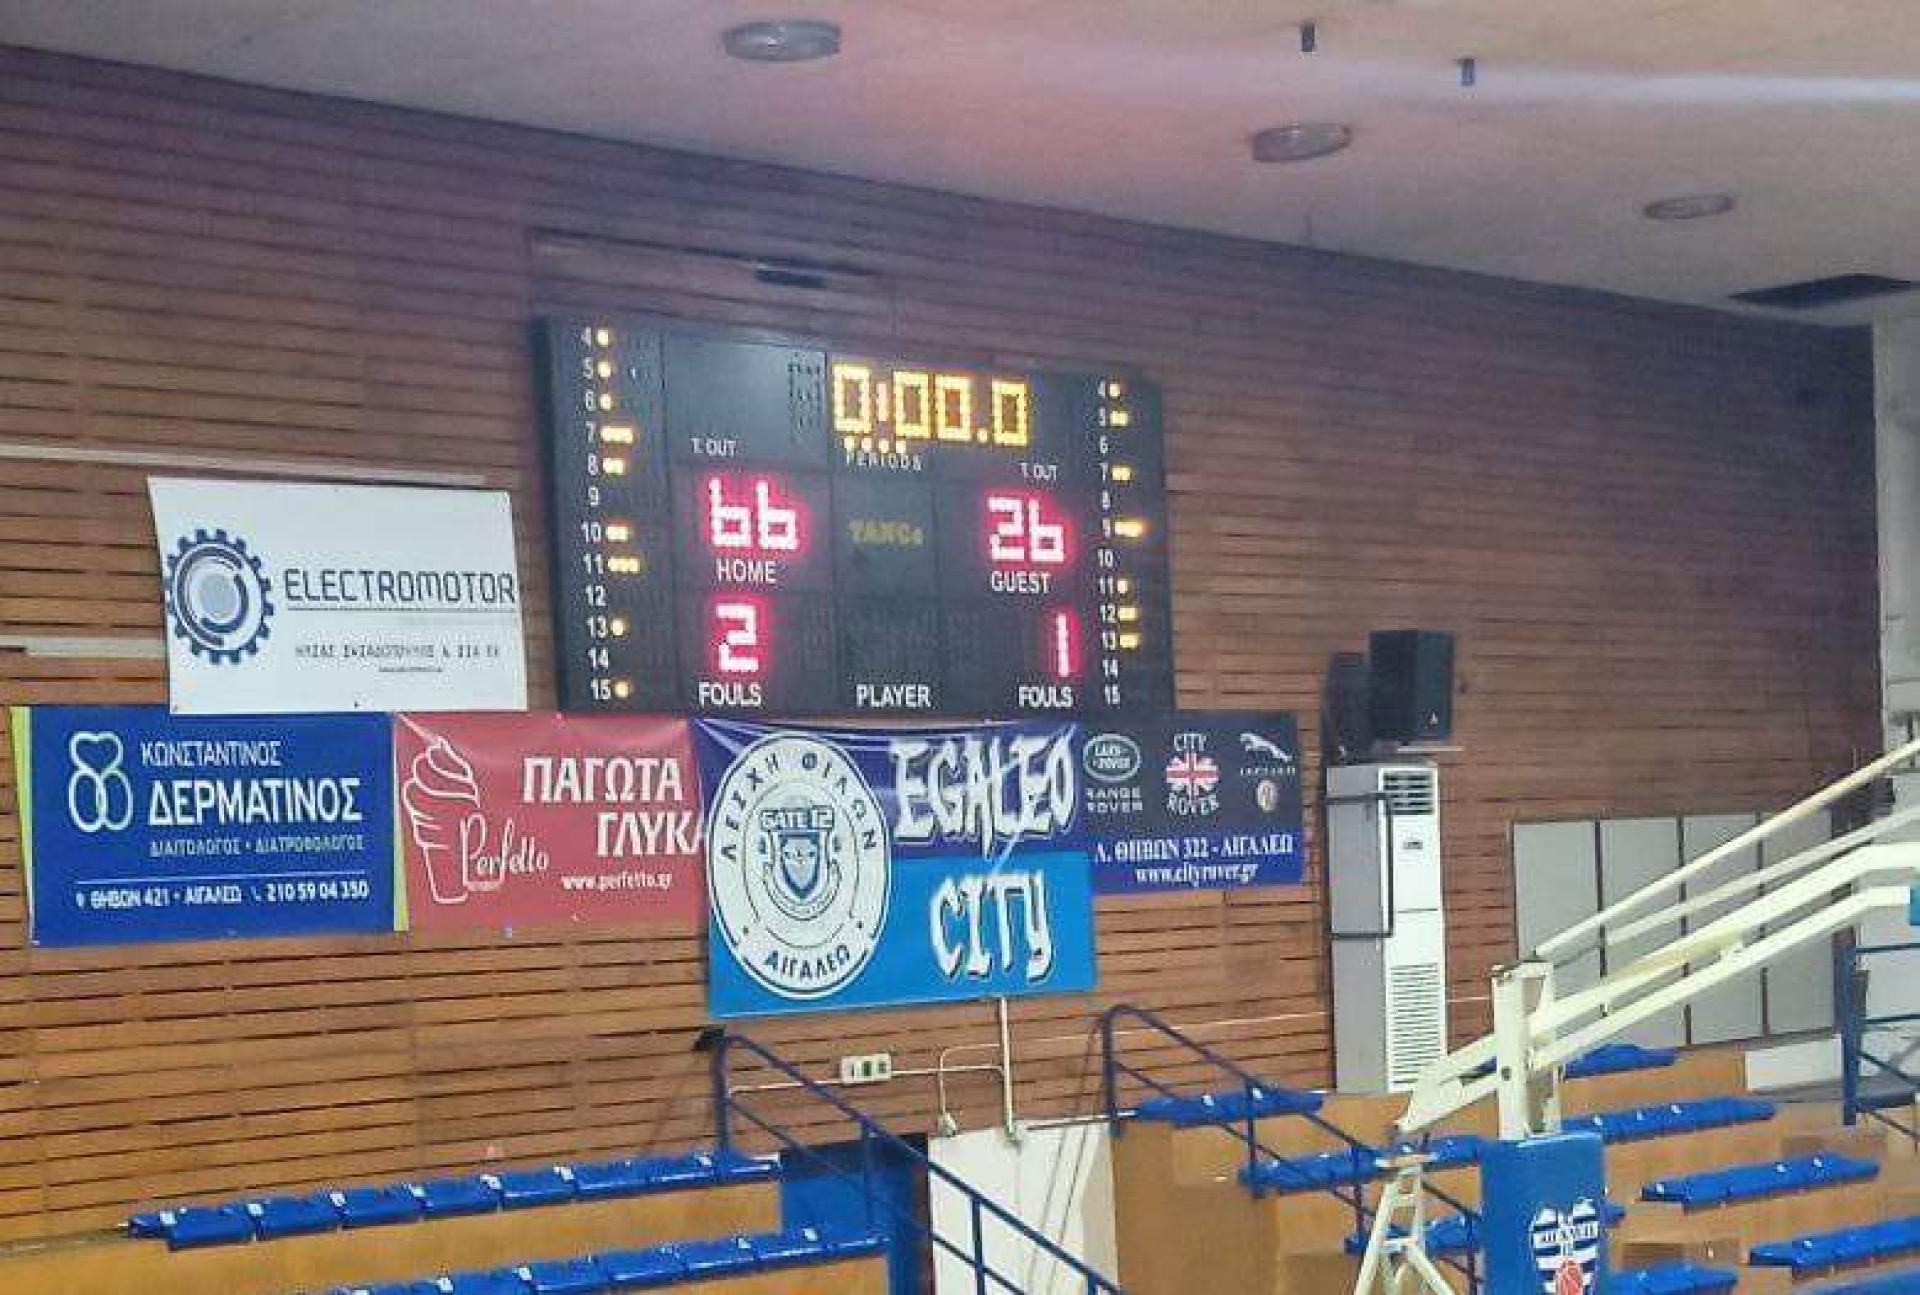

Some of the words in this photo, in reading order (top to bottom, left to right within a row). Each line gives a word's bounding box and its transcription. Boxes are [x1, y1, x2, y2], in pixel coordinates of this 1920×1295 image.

[587, 486, 599, 507] 9
[581, 521, 602, 542] 10
[583, 553, 604, 574] 11
[1098, 548, 1114, 567] 10
[716, 558, 777, 584] HOME
[991, 570, 1051, 594] GUEST
[284, 568, 516, 604] ELECTROMOTOR
[585, 585, 607, 607] 12
[587, 617, 608, 638] 13
[716, 602, 759, 672] 2
[1056, 612, 1070, 678] 1
[588, 648, 610, 671] 14
[1102, 659, 1119, 678] 14
[590, 680, 612, 701] 15
[698, 682, 763, 706] FOULS
[856, 683, 932, 708] PLAYER
[1018, 686, 1074, 708] FOULS
[140, 740, 282, 768] ΚΩΝΣΤΑΝΤΙΝΟΣ
[1174, 733, 1207, 752] CITY
[523, 757, 684, 803] ΠΑΓΩΤΑ
[148, 777, 363, 826] ΔΕΡΜΑΤΙΝΟΣ
[460, 814, 549, 887] Perfetto
[561, 872, 673, 892] www.perfetto.gr
[930, 871, 1056, 984] CITY
